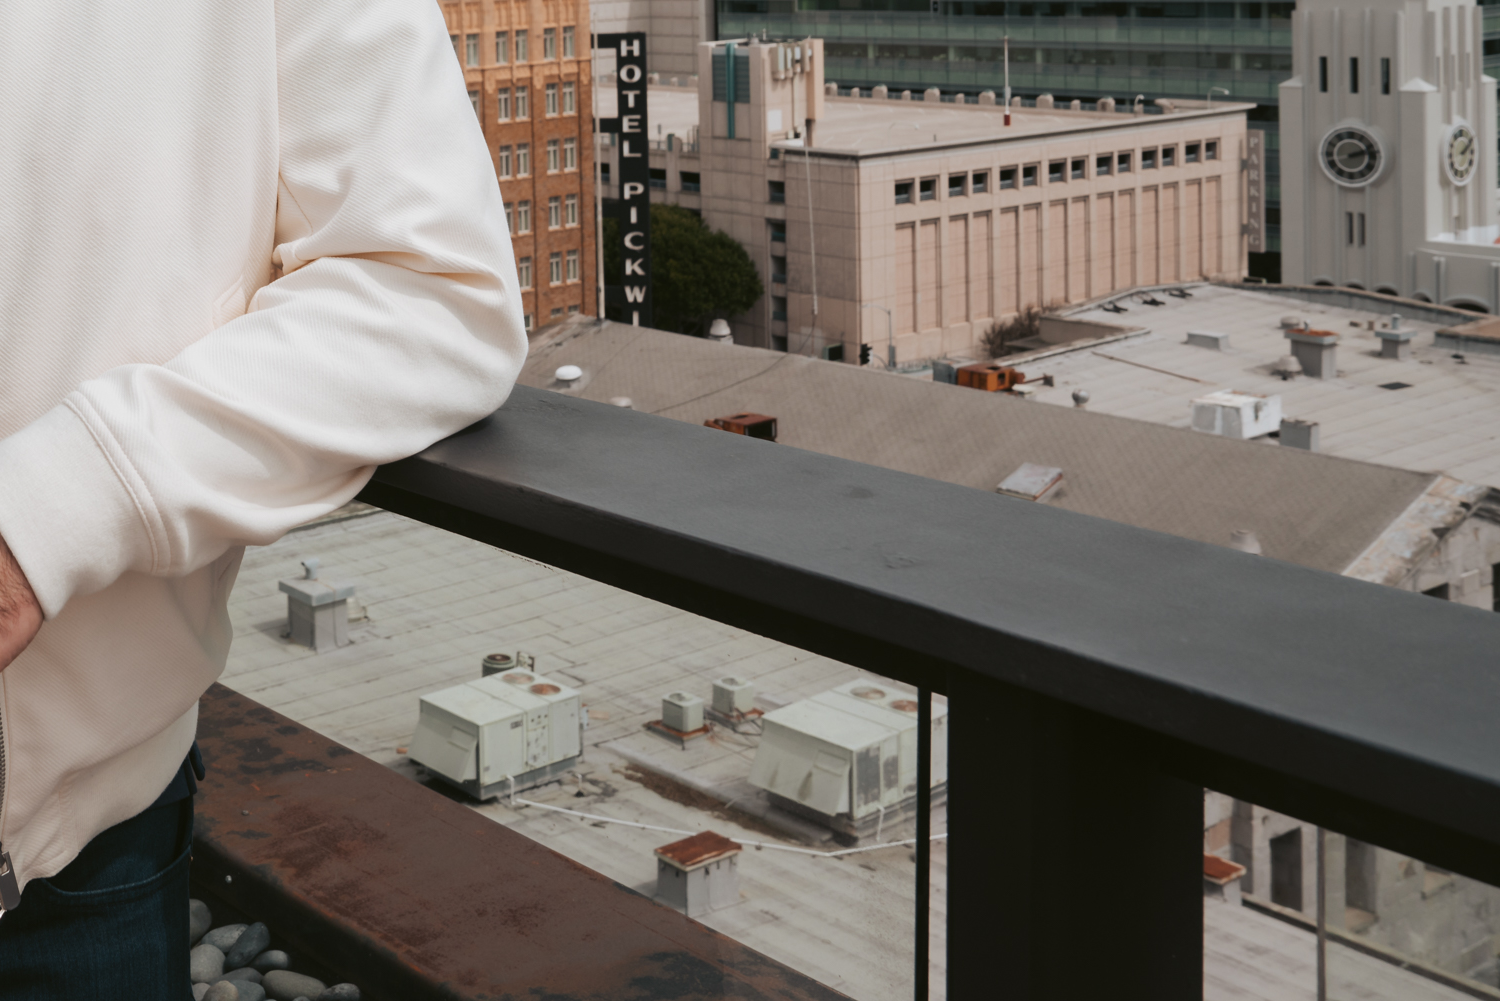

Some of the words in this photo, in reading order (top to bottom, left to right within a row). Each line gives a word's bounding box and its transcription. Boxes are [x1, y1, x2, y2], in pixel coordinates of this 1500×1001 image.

[619, 38, 642, 158] HOTEL
[1248, 136, 1260, 245] PARKING
[623, 181, 647, 327] PICKWI
